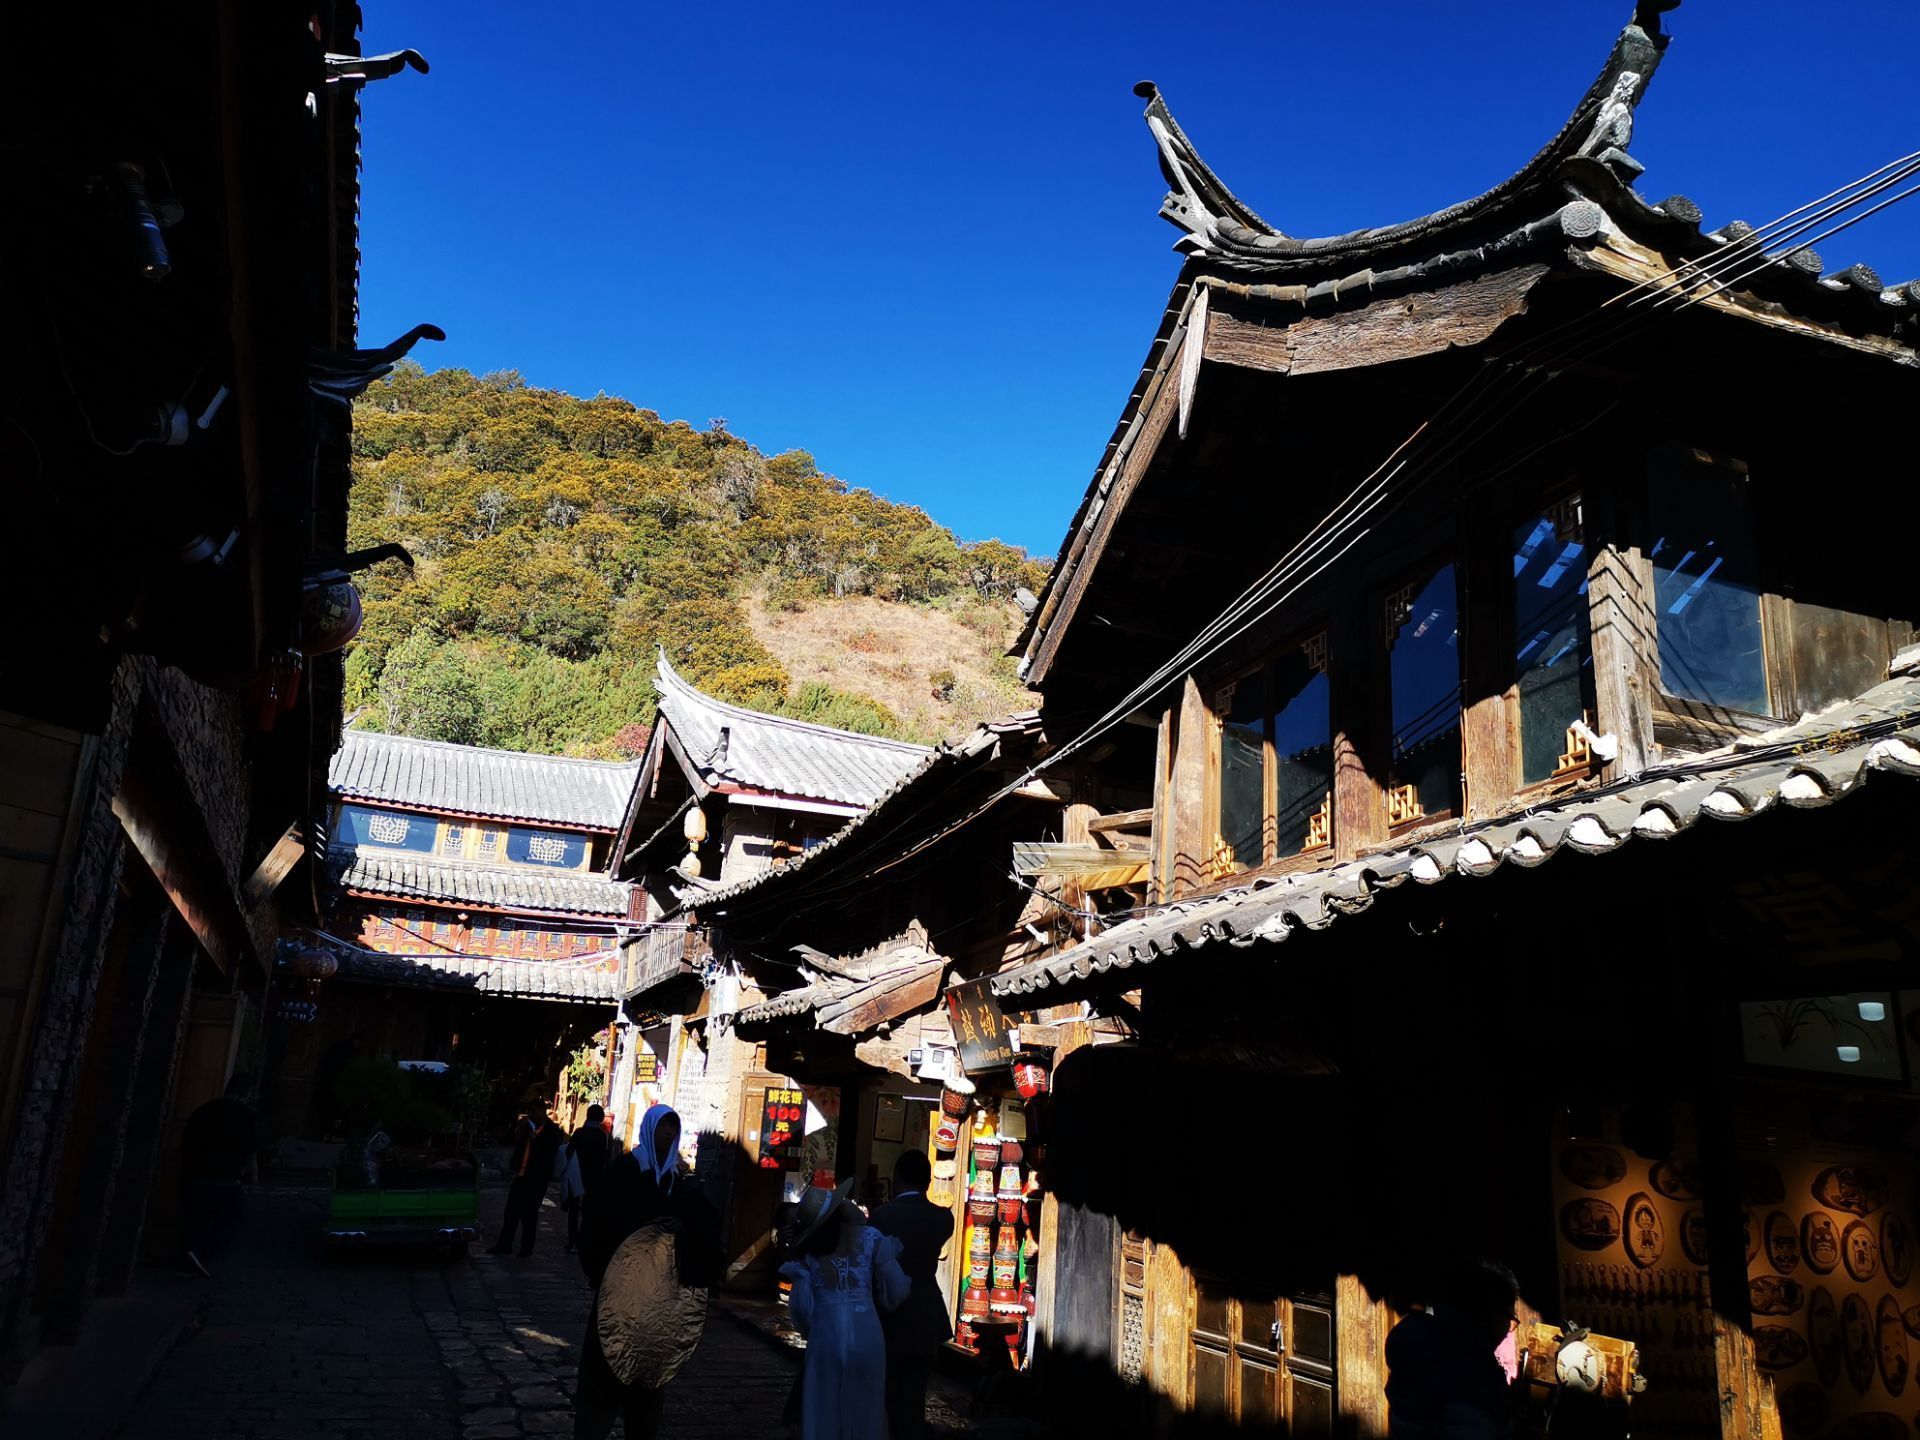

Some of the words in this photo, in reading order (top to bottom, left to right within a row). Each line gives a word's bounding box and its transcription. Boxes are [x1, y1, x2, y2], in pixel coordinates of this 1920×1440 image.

[768, 1089, 803, 1105] 鲜花饼
[767, 1105, 801, 1122] 100
[775, 1121, 790, 1132] 元
